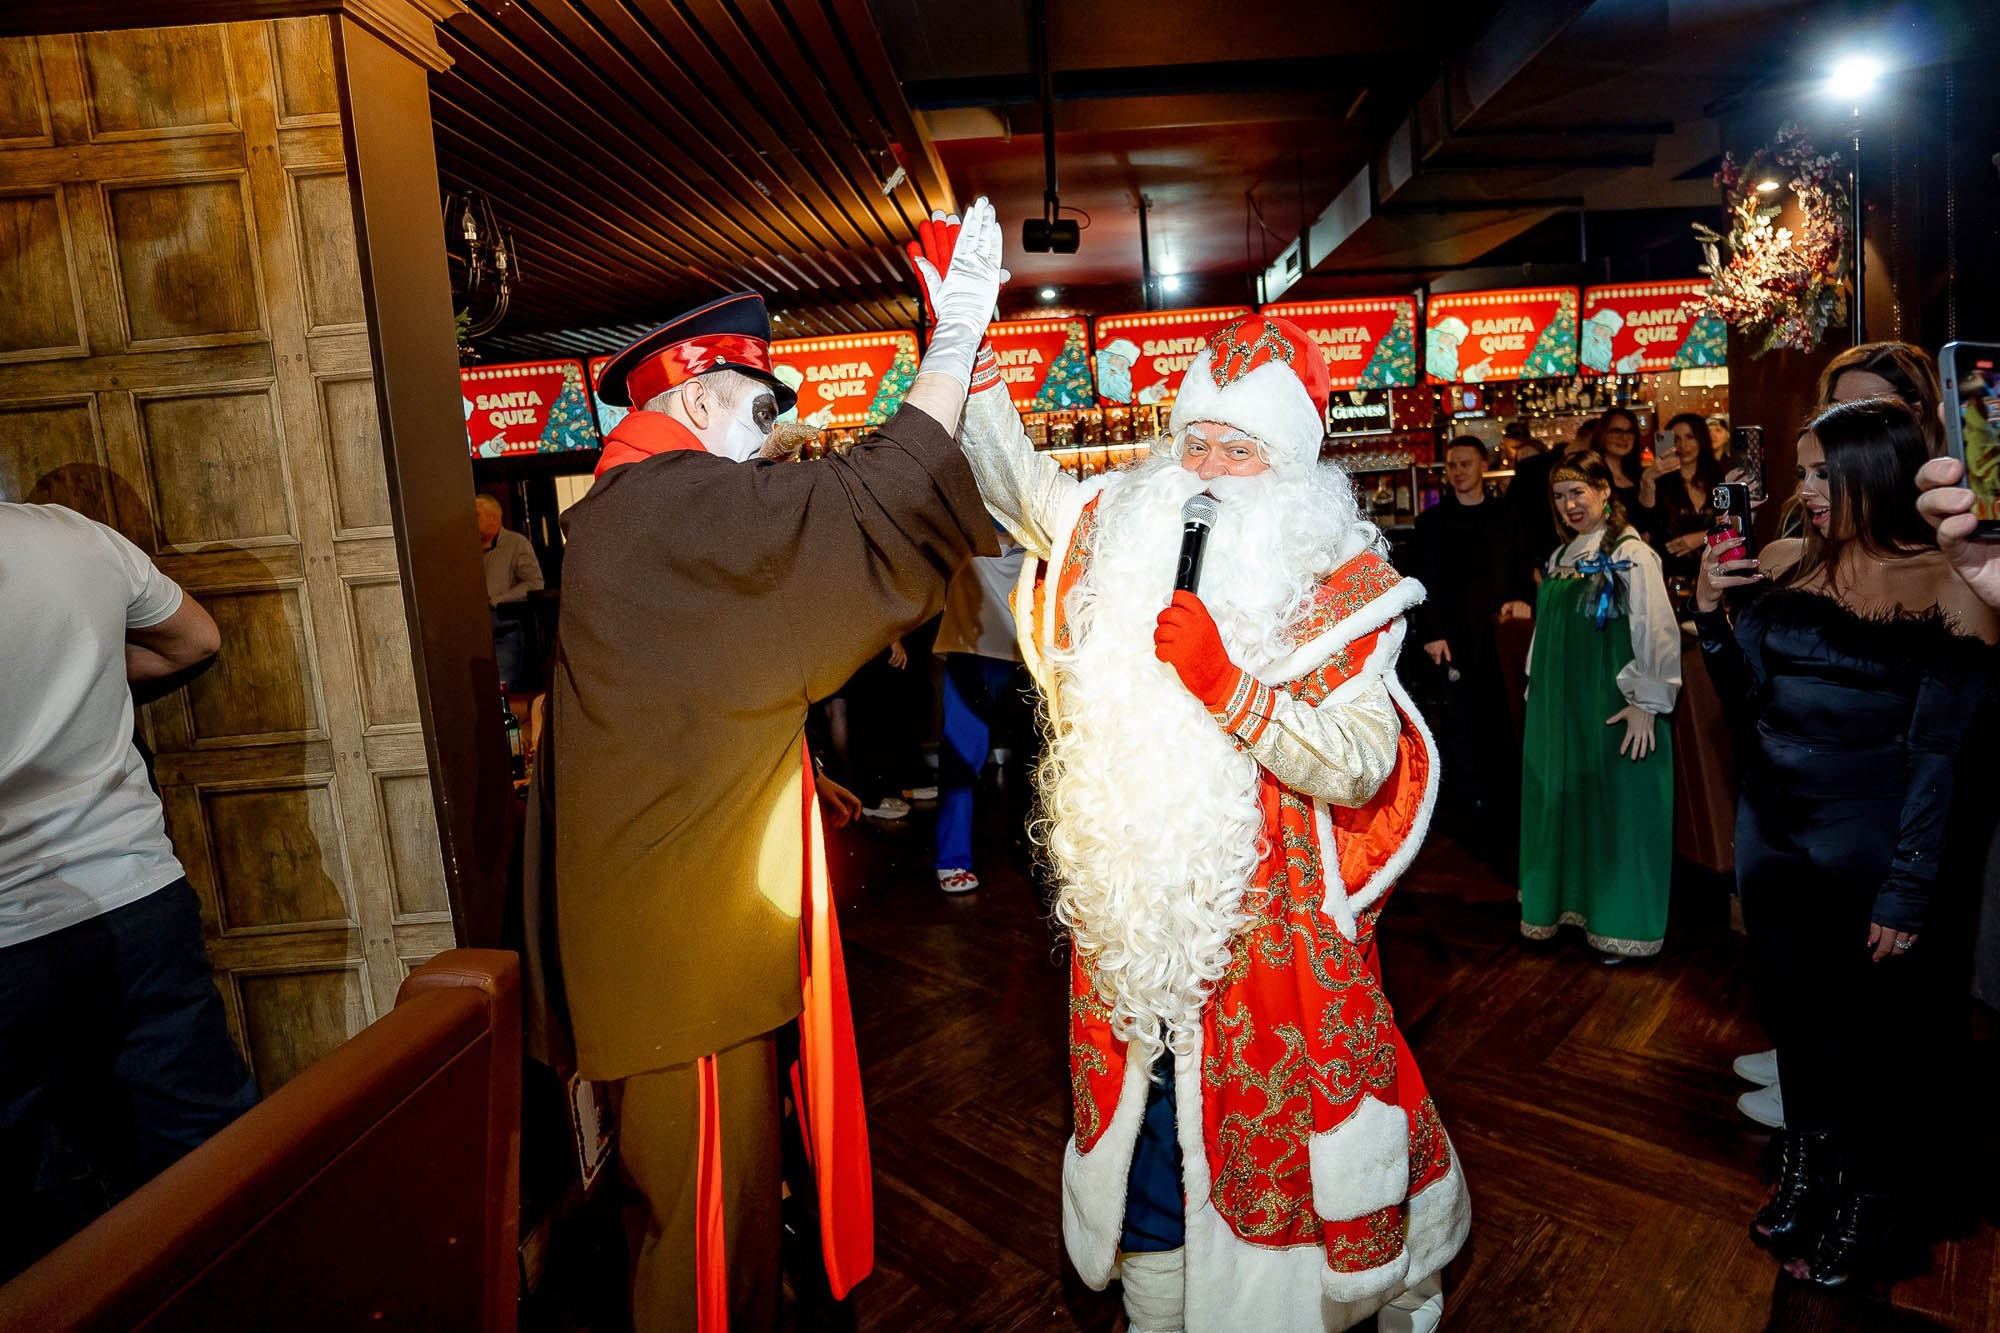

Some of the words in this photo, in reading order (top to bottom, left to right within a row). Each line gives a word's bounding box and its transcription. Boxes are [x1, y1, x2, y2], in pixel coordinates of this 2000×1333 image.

[1471, 316, 1535, 335] SANTA
[1626, 307, 1687, 327] SANTA
[1479, 334, 1526, 354] QUIZ
[1633, 325, 1678, 346] QUIZ
[805, 361, 874, 382] SANTA
[1000, 366, 1036, 384] UIZ
[817, 380, 867, 401] QUIZ
[476, 391, 543, 411] SANTA
[489, 408, 537, 429] QUIZ
[1331, 403, 1386, 420] GUINNESS
